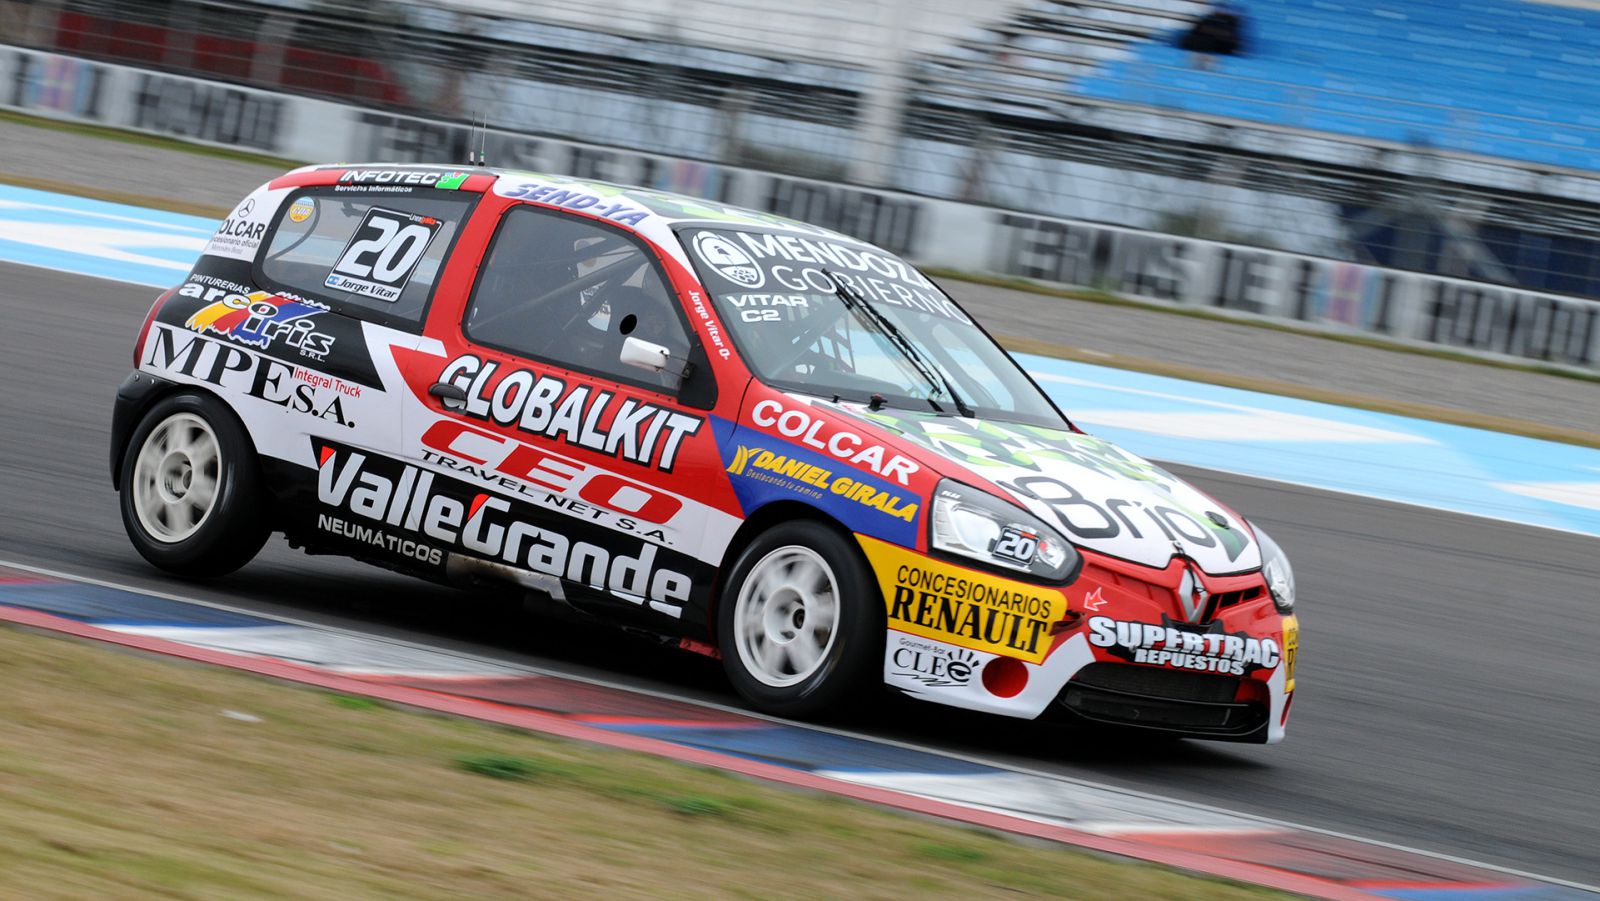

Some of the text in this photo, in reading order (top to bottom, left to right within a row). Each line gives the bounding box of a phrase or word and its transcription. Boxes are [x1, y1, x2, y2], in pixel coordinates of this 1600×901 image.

[340, 169, 441, 185] INFOTEC
[505, 184, 650, 226] SEND-YA
[335, 215, 431, 283] 20
[736, 231, 938, 291] MENDOZA
[190, 273, 251, 294] PINTURERIAS
[337, 276, 398, 299] Jorge Vitar
[726, 294, 809, 307] VITAR
[770, 264, 973, 326] GOBIERNO
[688, 290, 709, 320] Jorge
[704, 320, 724, 348] Vitar
[741, 309, 781, 323] C2
[294, 366, 362, 398] Integral Truck
[300, 349, 325, 362] S.R.L.
[440, 356, 704, 472] GLOBALKIT
[751, 399, 920, 486] COLCAR
[420, 419, 683, 525] CEO
[420, 449, 675, 545] TRAVEL NET S.A.
[752, 450, 919, 523] DANIEL GIRALA
[317, 446, 692, 619] ValleGrande
[318, 514, 443, 566] NEUMÁTICOS
[996, 531, 1036, 560] 20
[897, 563, 1052, 619] CONCESIONARIOS
[888, 584, 1048, 655] RENAULT
[1088, 616, 1280, 669] SUPERTRAC
[1134, 648, 1245, 676] REPUESTOS
